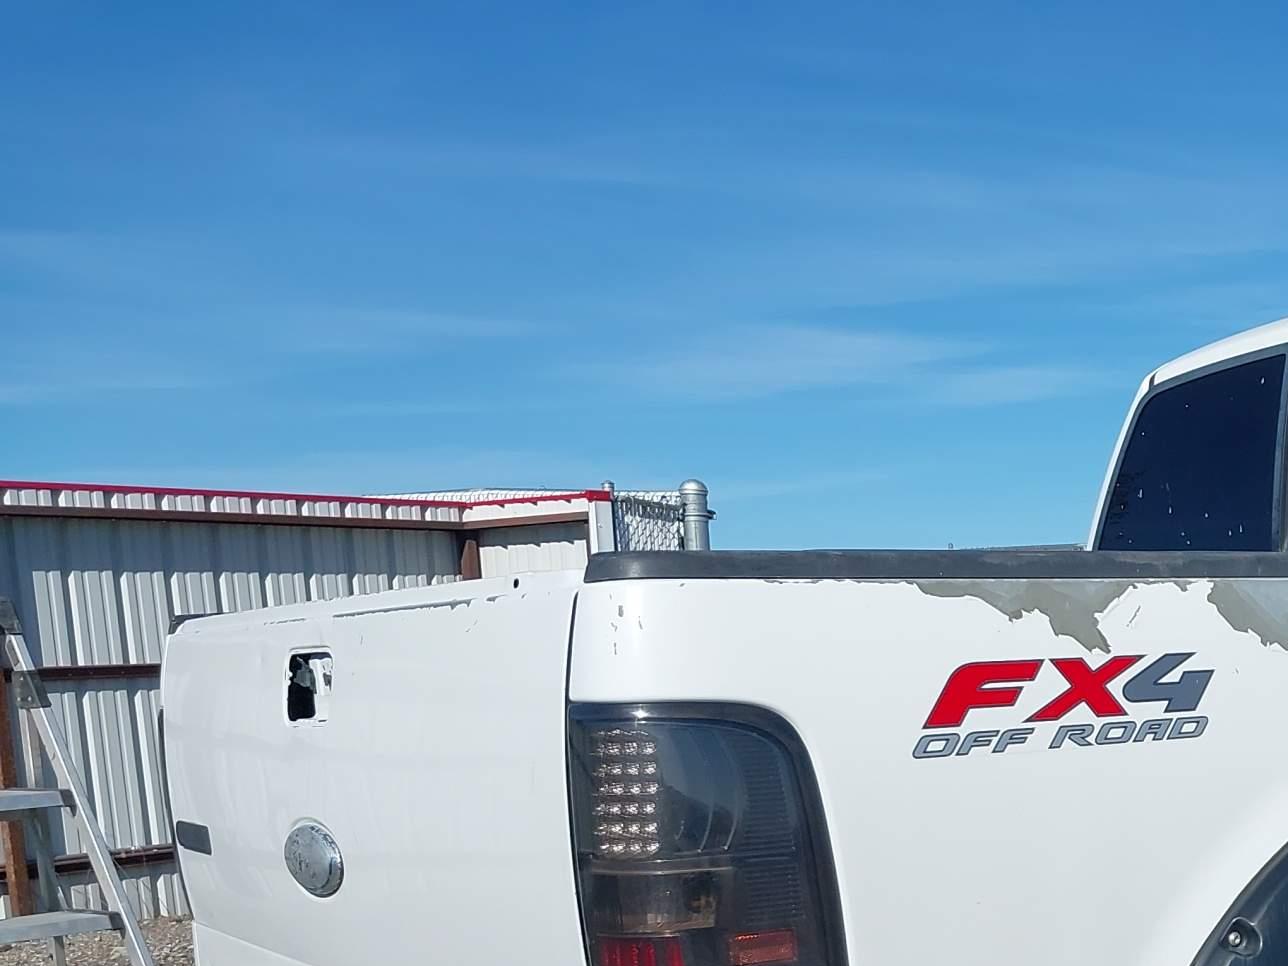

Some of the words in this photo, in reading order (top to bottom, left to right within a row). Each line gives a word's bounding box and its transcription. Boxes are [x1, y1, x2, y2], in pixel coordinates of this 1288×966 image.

[921, 651, 1216, 730] FX4
[911, 727, 1036, 760] OFF
[1048, 715, 1209, 750] ROAD
